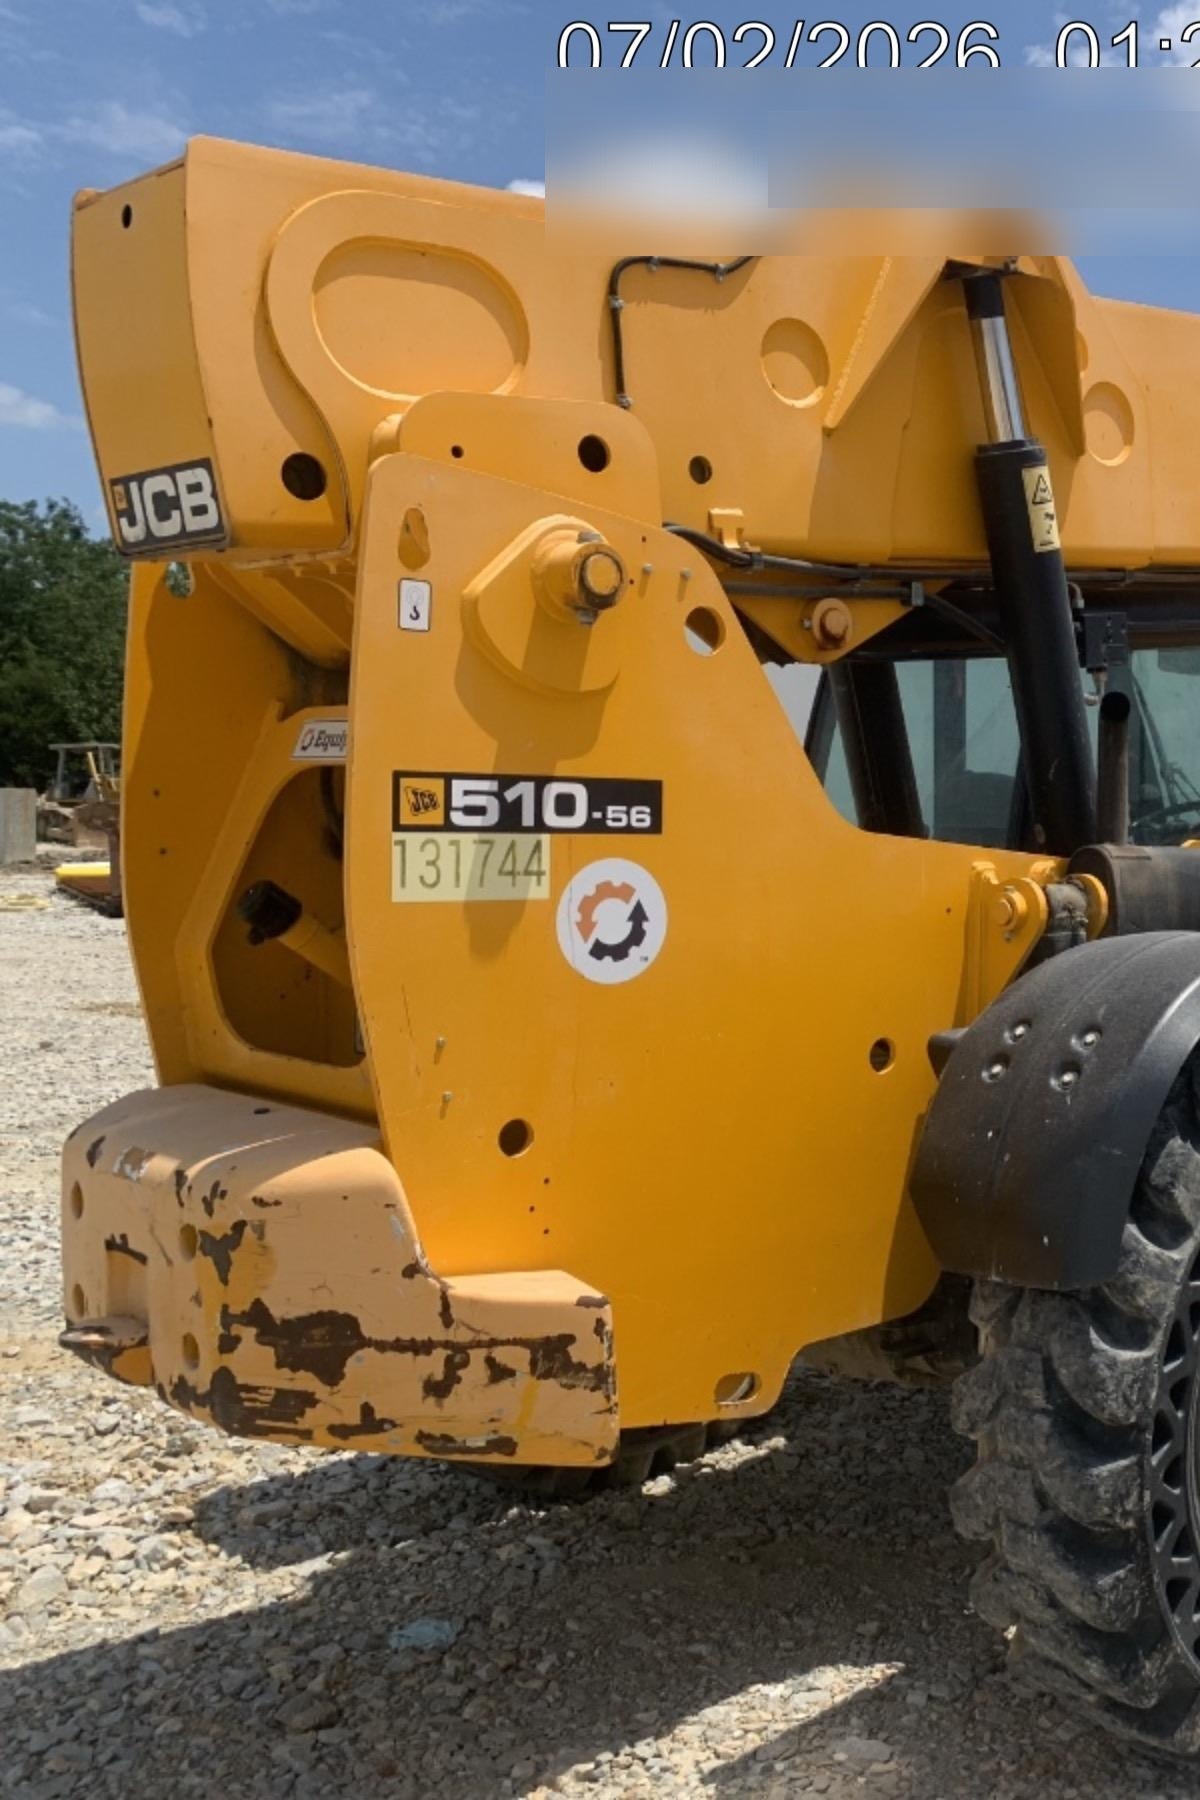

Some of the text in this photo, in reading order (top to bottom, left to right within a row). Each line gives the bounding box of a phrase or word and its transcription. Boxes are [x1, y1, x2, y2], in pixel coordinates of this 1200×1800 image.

[119, 466, 221, 544] JCB
[449, 778, 652, 829] 510-56
[393, 838, 547, 889] 131744
